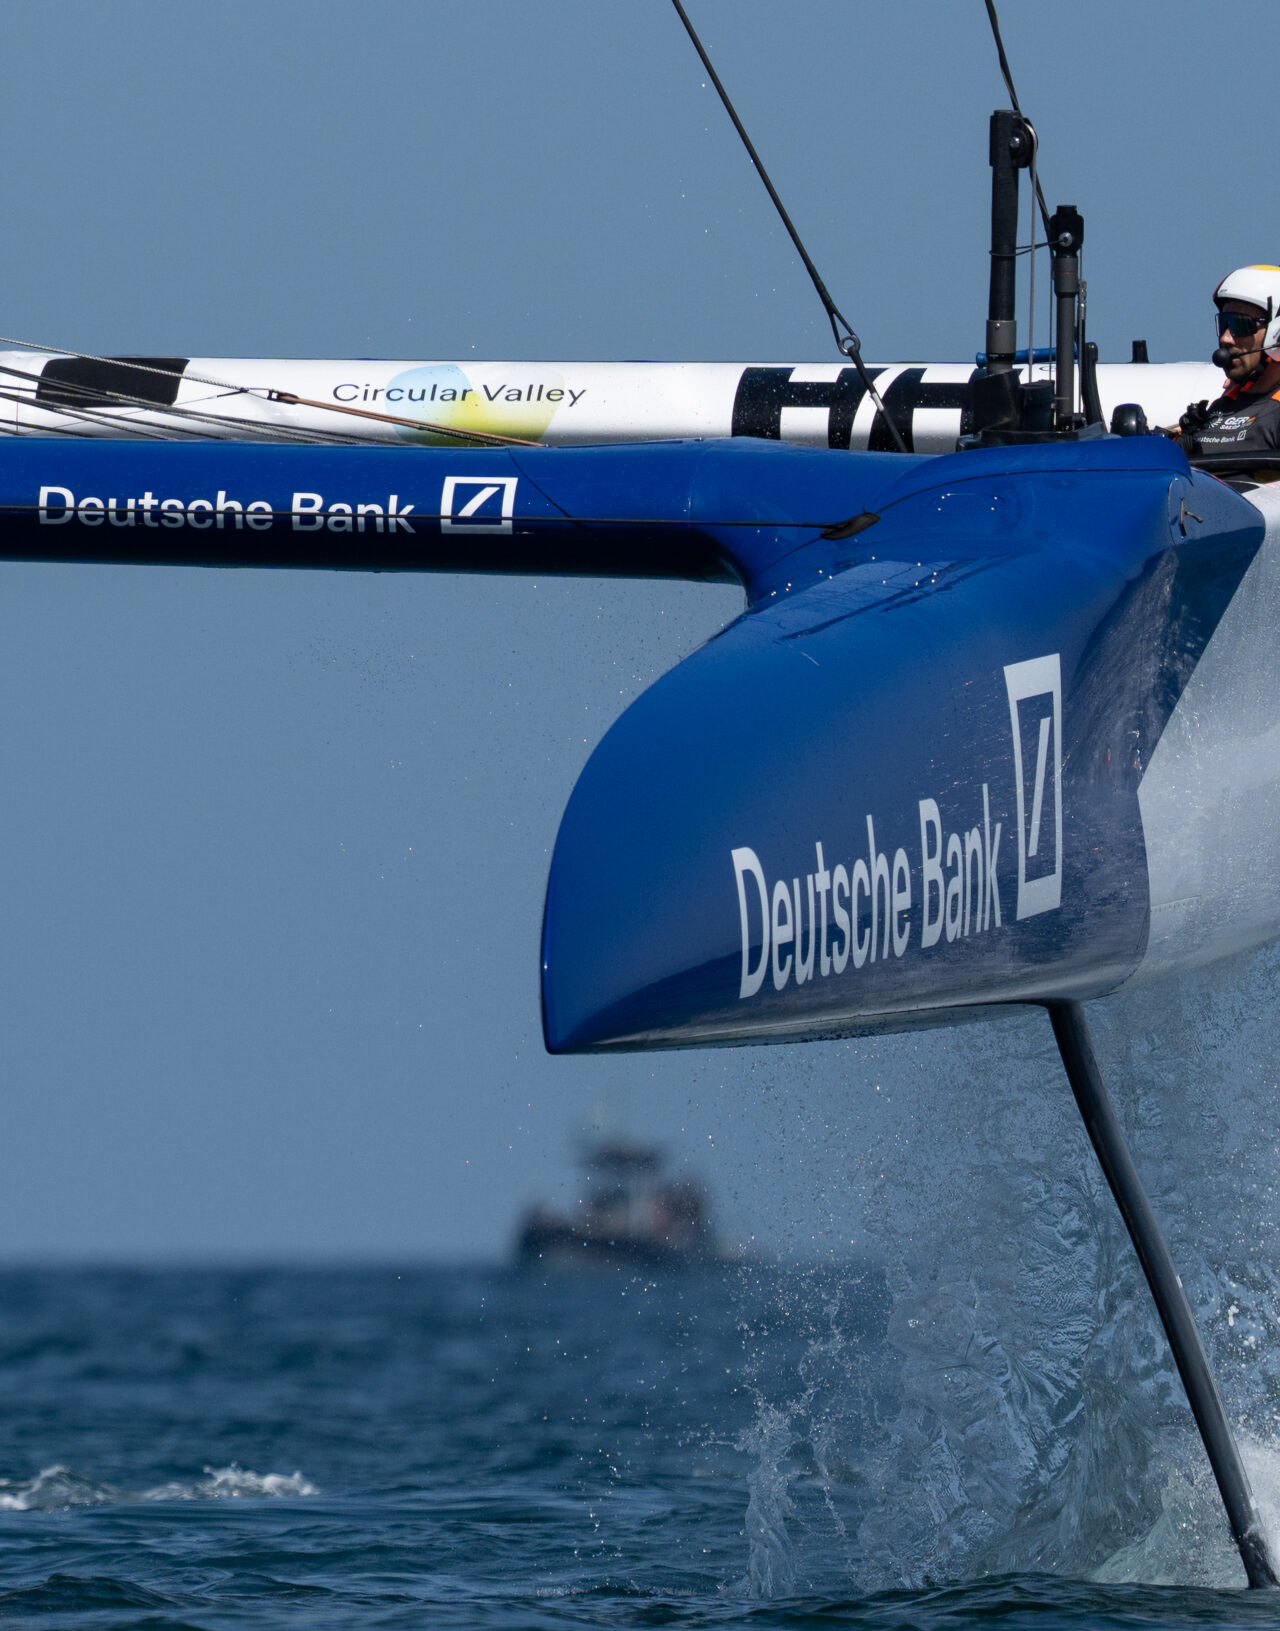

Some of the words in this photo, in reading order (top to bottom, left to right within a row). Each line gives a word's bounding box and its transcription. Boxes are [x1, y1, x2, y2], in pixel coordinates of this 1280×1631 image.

[332, 383, 472, 403] Circular
[481, 382, 587, 408] Valley
[38, 485, 274, 530] Deutsche
[292, 491, 416, 534] Bank
[731, 814, 911, 999] Deutsche
[918, 783, 1002, 949] Bank
